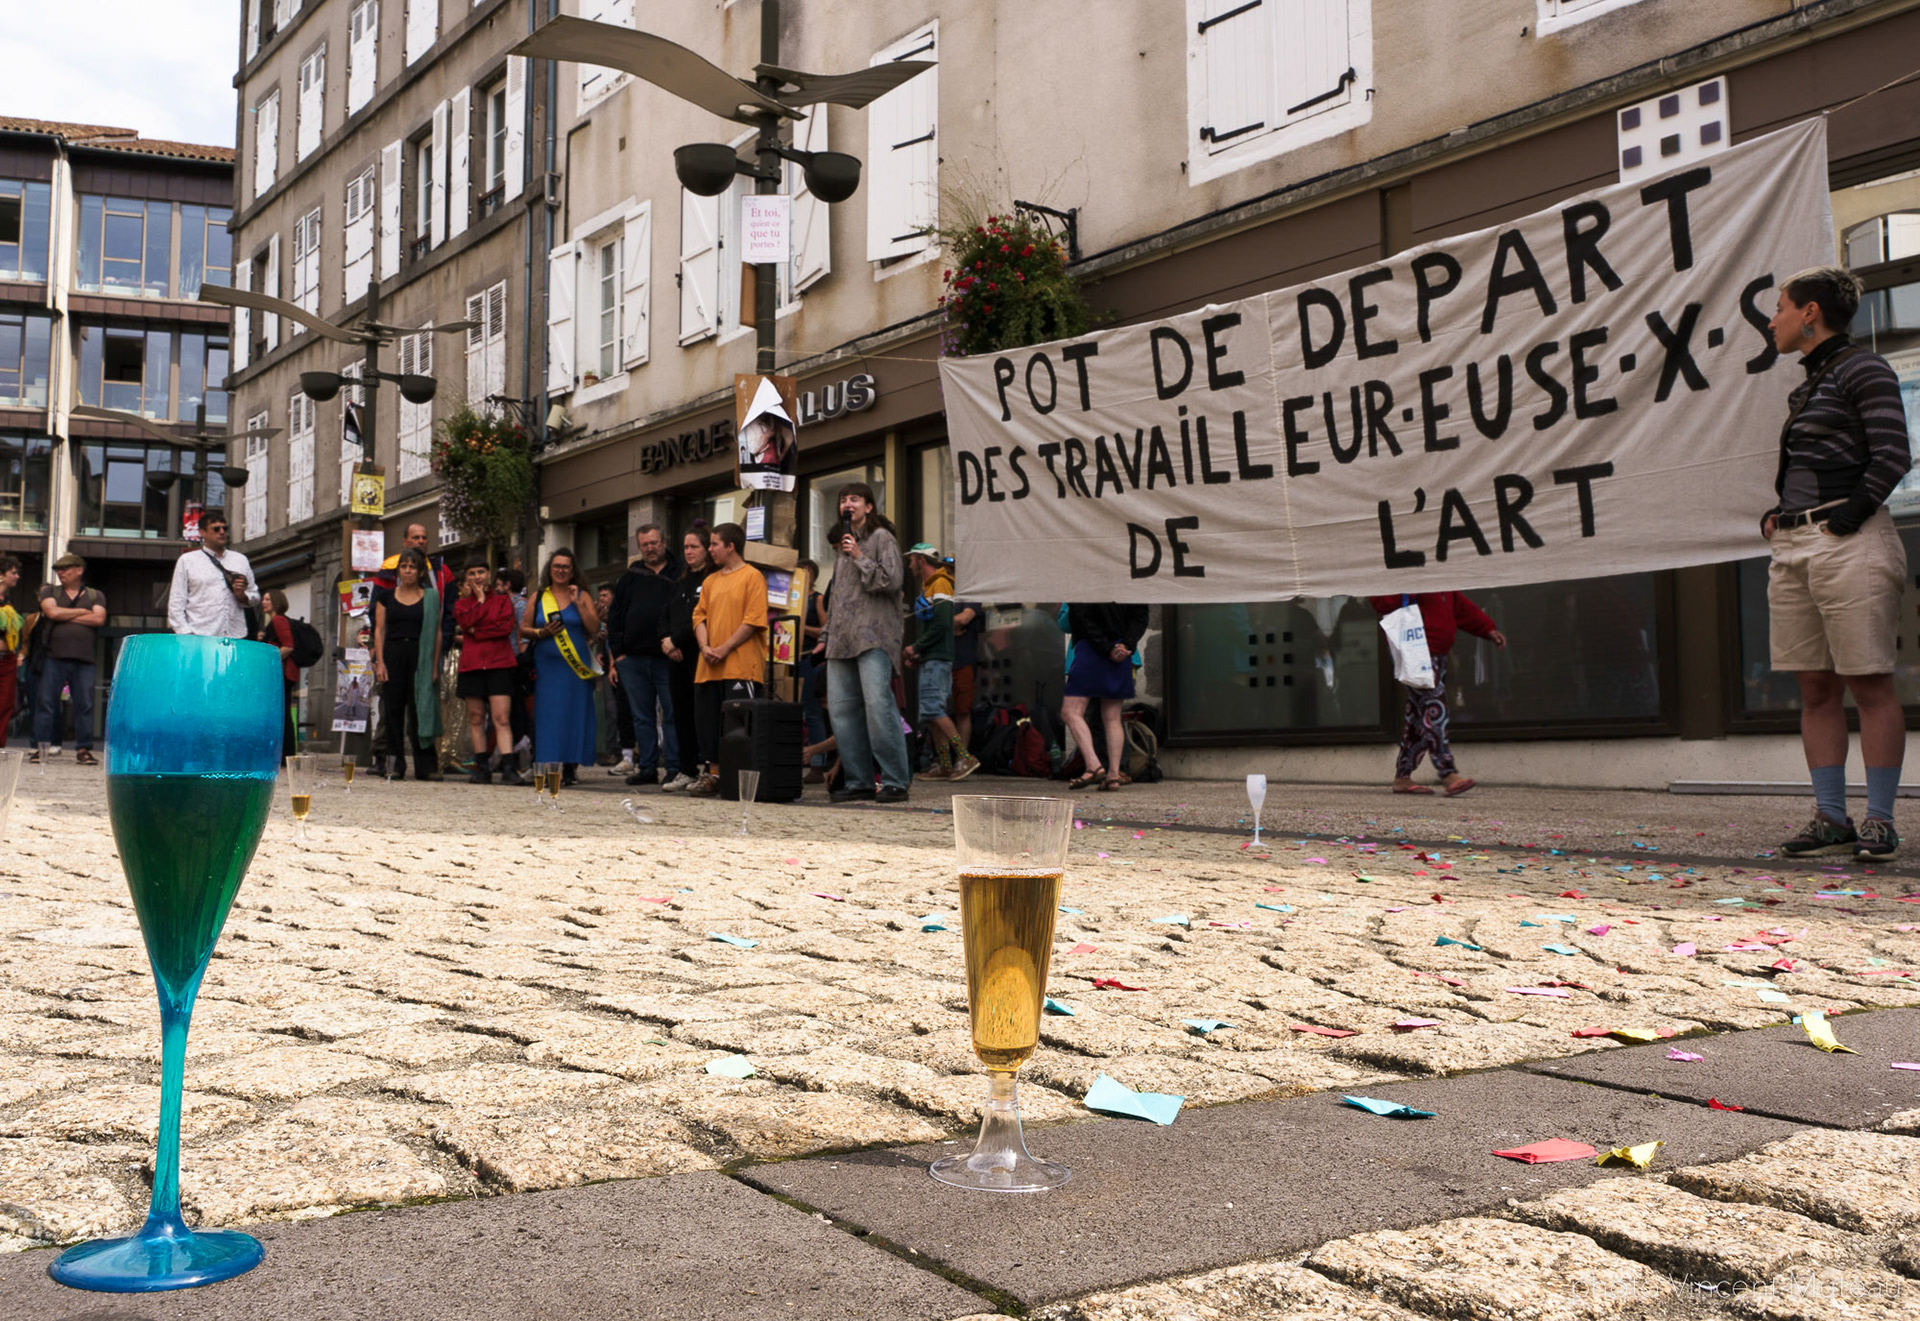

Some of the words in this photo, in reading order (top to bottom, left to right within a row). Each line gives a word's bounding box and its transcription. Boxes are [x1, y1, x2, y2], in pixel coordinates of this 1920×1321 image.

[751, 208, 761, 218] Et
[764, 207, 781, 219] toi,
[750, 230, 768, 240] que
[750, 241, 775, 250] portes
[994, 341, 1099, 422] POT
[1150, 312, 1246, 400] DE
[1297, 166, 1712, 370] DEPART
[640, 420, 731, 476] BANQUE
[796, 373, 876, 427] LUS
[957, 445, 1030, 505] DES
[1126, 516, 1206, 580] DE
[1378, 460, 1615, 570] L'ART
[1406, 626, 1425, 642] AC
